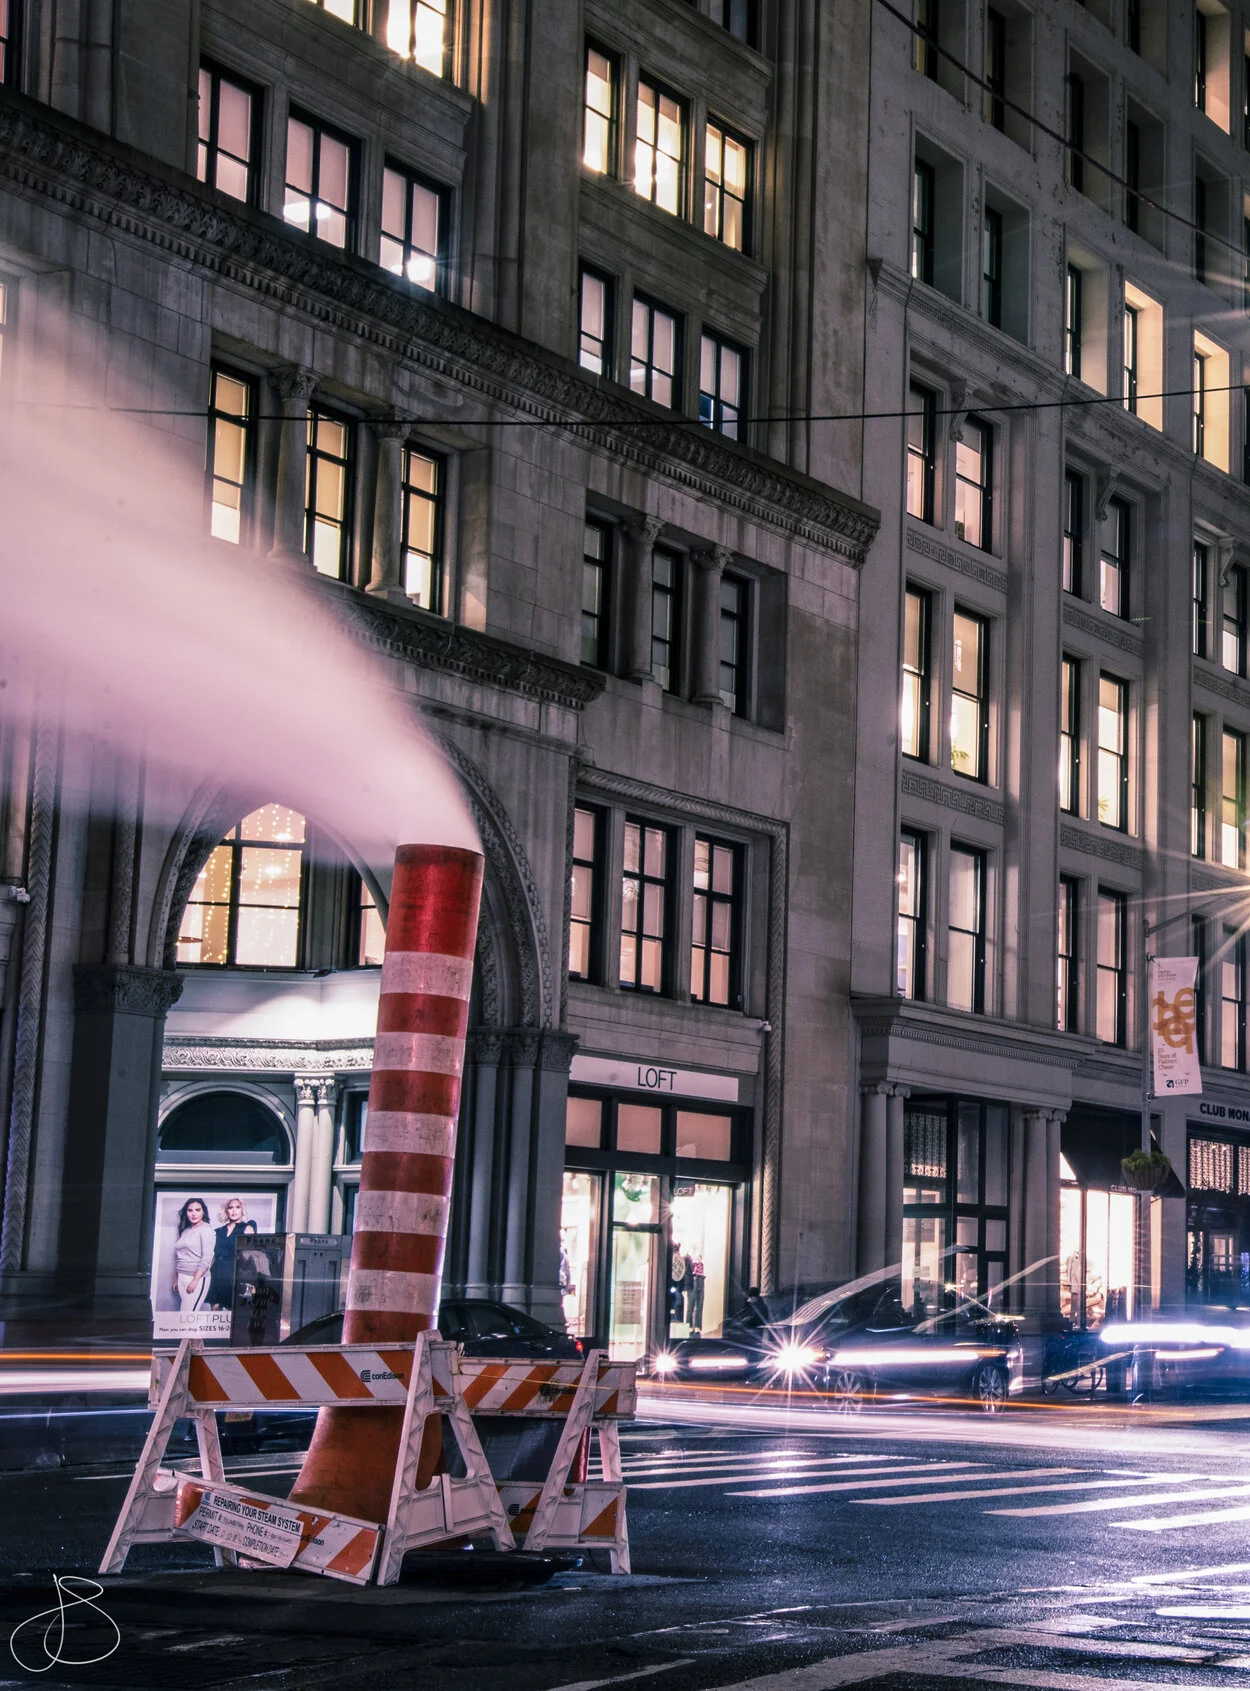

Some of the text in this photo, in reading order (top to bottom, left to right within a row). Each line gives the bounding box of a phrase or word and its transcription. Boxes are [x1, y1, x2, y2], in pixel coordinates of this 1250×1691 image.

[637, 1066, 677, 1091] LOFT
[1200, 1102, 1226, 1117] CLUB
[674, 1187, 693, 1196] LOFT
[1110, 1184, 1127, 1192] CLUB
[371, 1371, 404, 1380] conEdison
[198, 1506, 219, 1520] PERMIT
[213, 1495, 241, 1513] REPAIRING
[241, 1503, 258, 1518] YOUR
[258, 1509, 277, 1525] STEAM
[277, 1516, 301, 1532] SYSTEM
[192, 1519, 207, 1531] START
[246, 1522, 264, 1535] PHONE
[242, 1536, 268, 1554] COMPLETION
